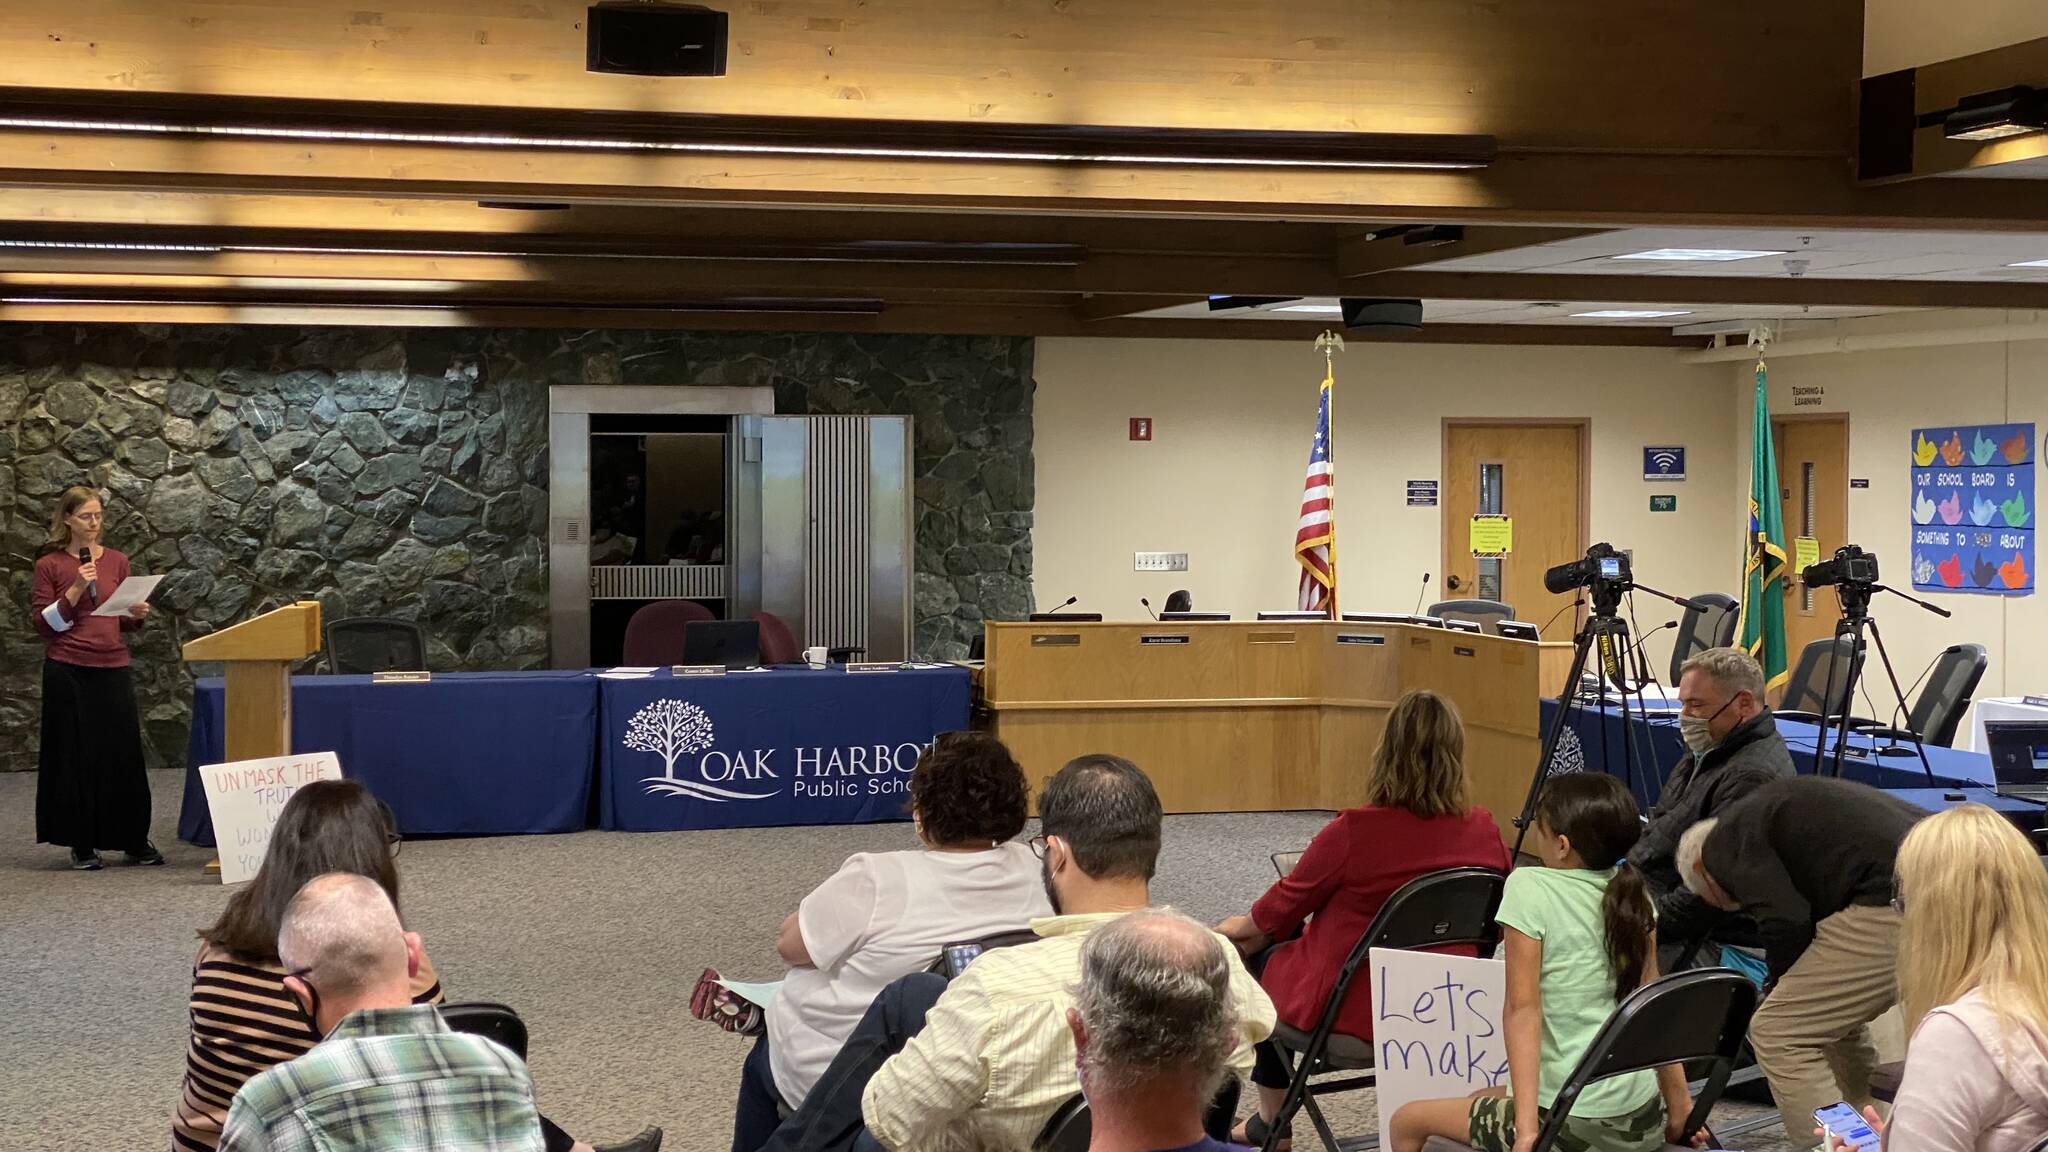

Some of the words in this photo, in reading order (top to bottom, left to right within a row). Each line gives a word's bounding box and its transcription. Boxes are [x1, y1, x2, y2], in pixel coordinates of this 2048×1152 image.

[1917, 473, 1931, 486] OUR
[1937, 473, 1963, 486] SCHOOL
[1971, 473, 1995, 486] BOARD
[2006, 472, 2015, 486] IS
[1916, 530, 1949, 546] SOMETHING
[1956, 532, 1966, 546] TO
[2000, 533, 2025, 549] ABOUT
[1601, 635, 1609, 655] Nikon
[700, 748, 780, 781] OAK
[795, 742, 932, 777] HARBO
[293, 761, 325, 784] THE
[254, 786, 298, 806] TRUT
[794, 778, 858, 798] Public
[867, 776, 913, 796] Scho
[236, 827, 272, 847] WON
